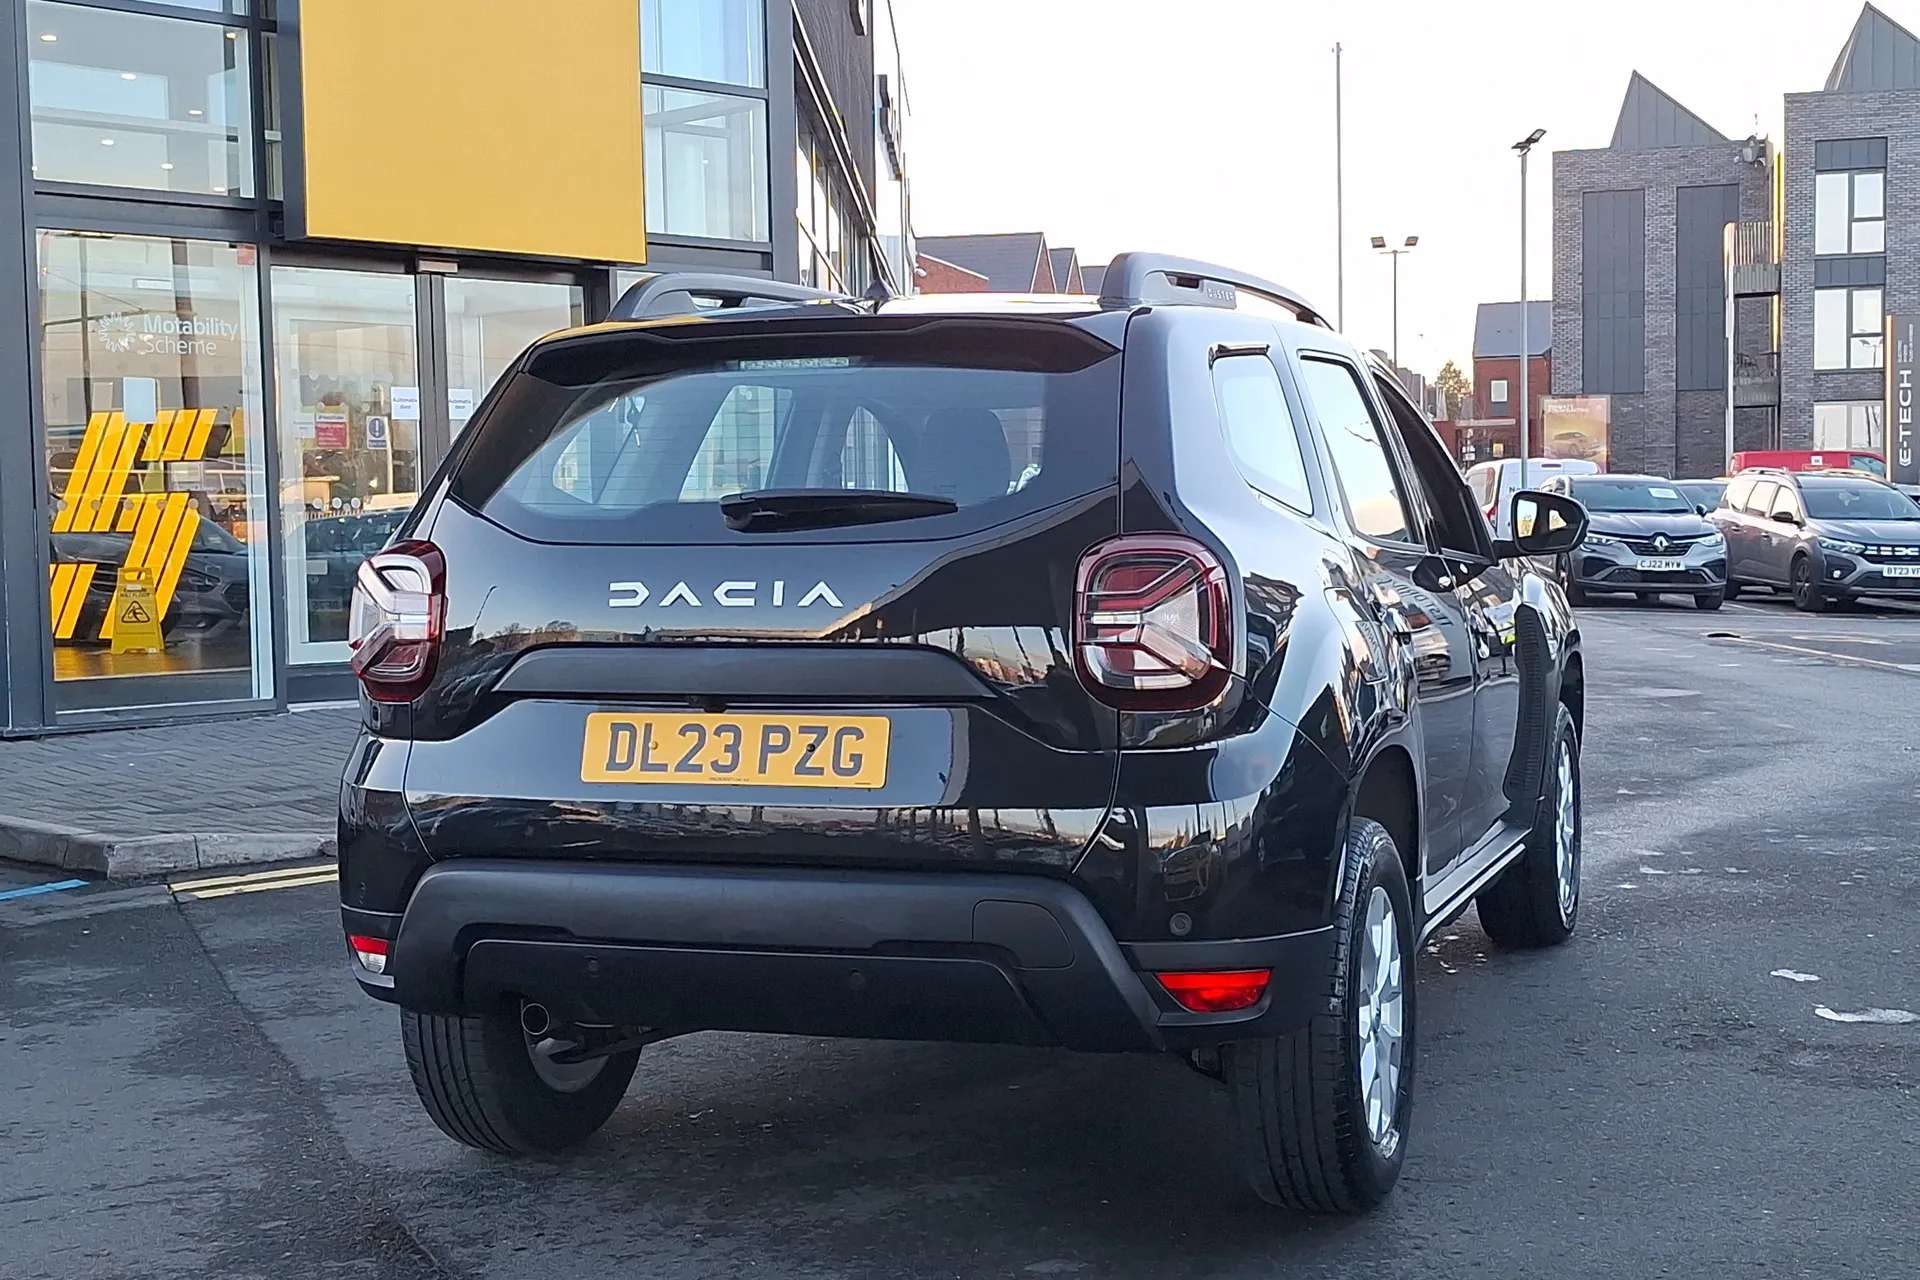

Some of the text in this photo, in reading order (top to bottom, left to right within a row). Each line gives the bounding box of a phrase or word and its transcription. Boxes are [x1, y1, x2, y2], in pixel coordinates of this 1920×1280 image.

[143, 314, 239, 341] Motability
[143, 334, 217, 356] Scheme
[1899, 369, 1913, 466] E-TECH
[608, 580, 845, 607] DACIA
[605, 722, 864, 777] DL23 PZG
